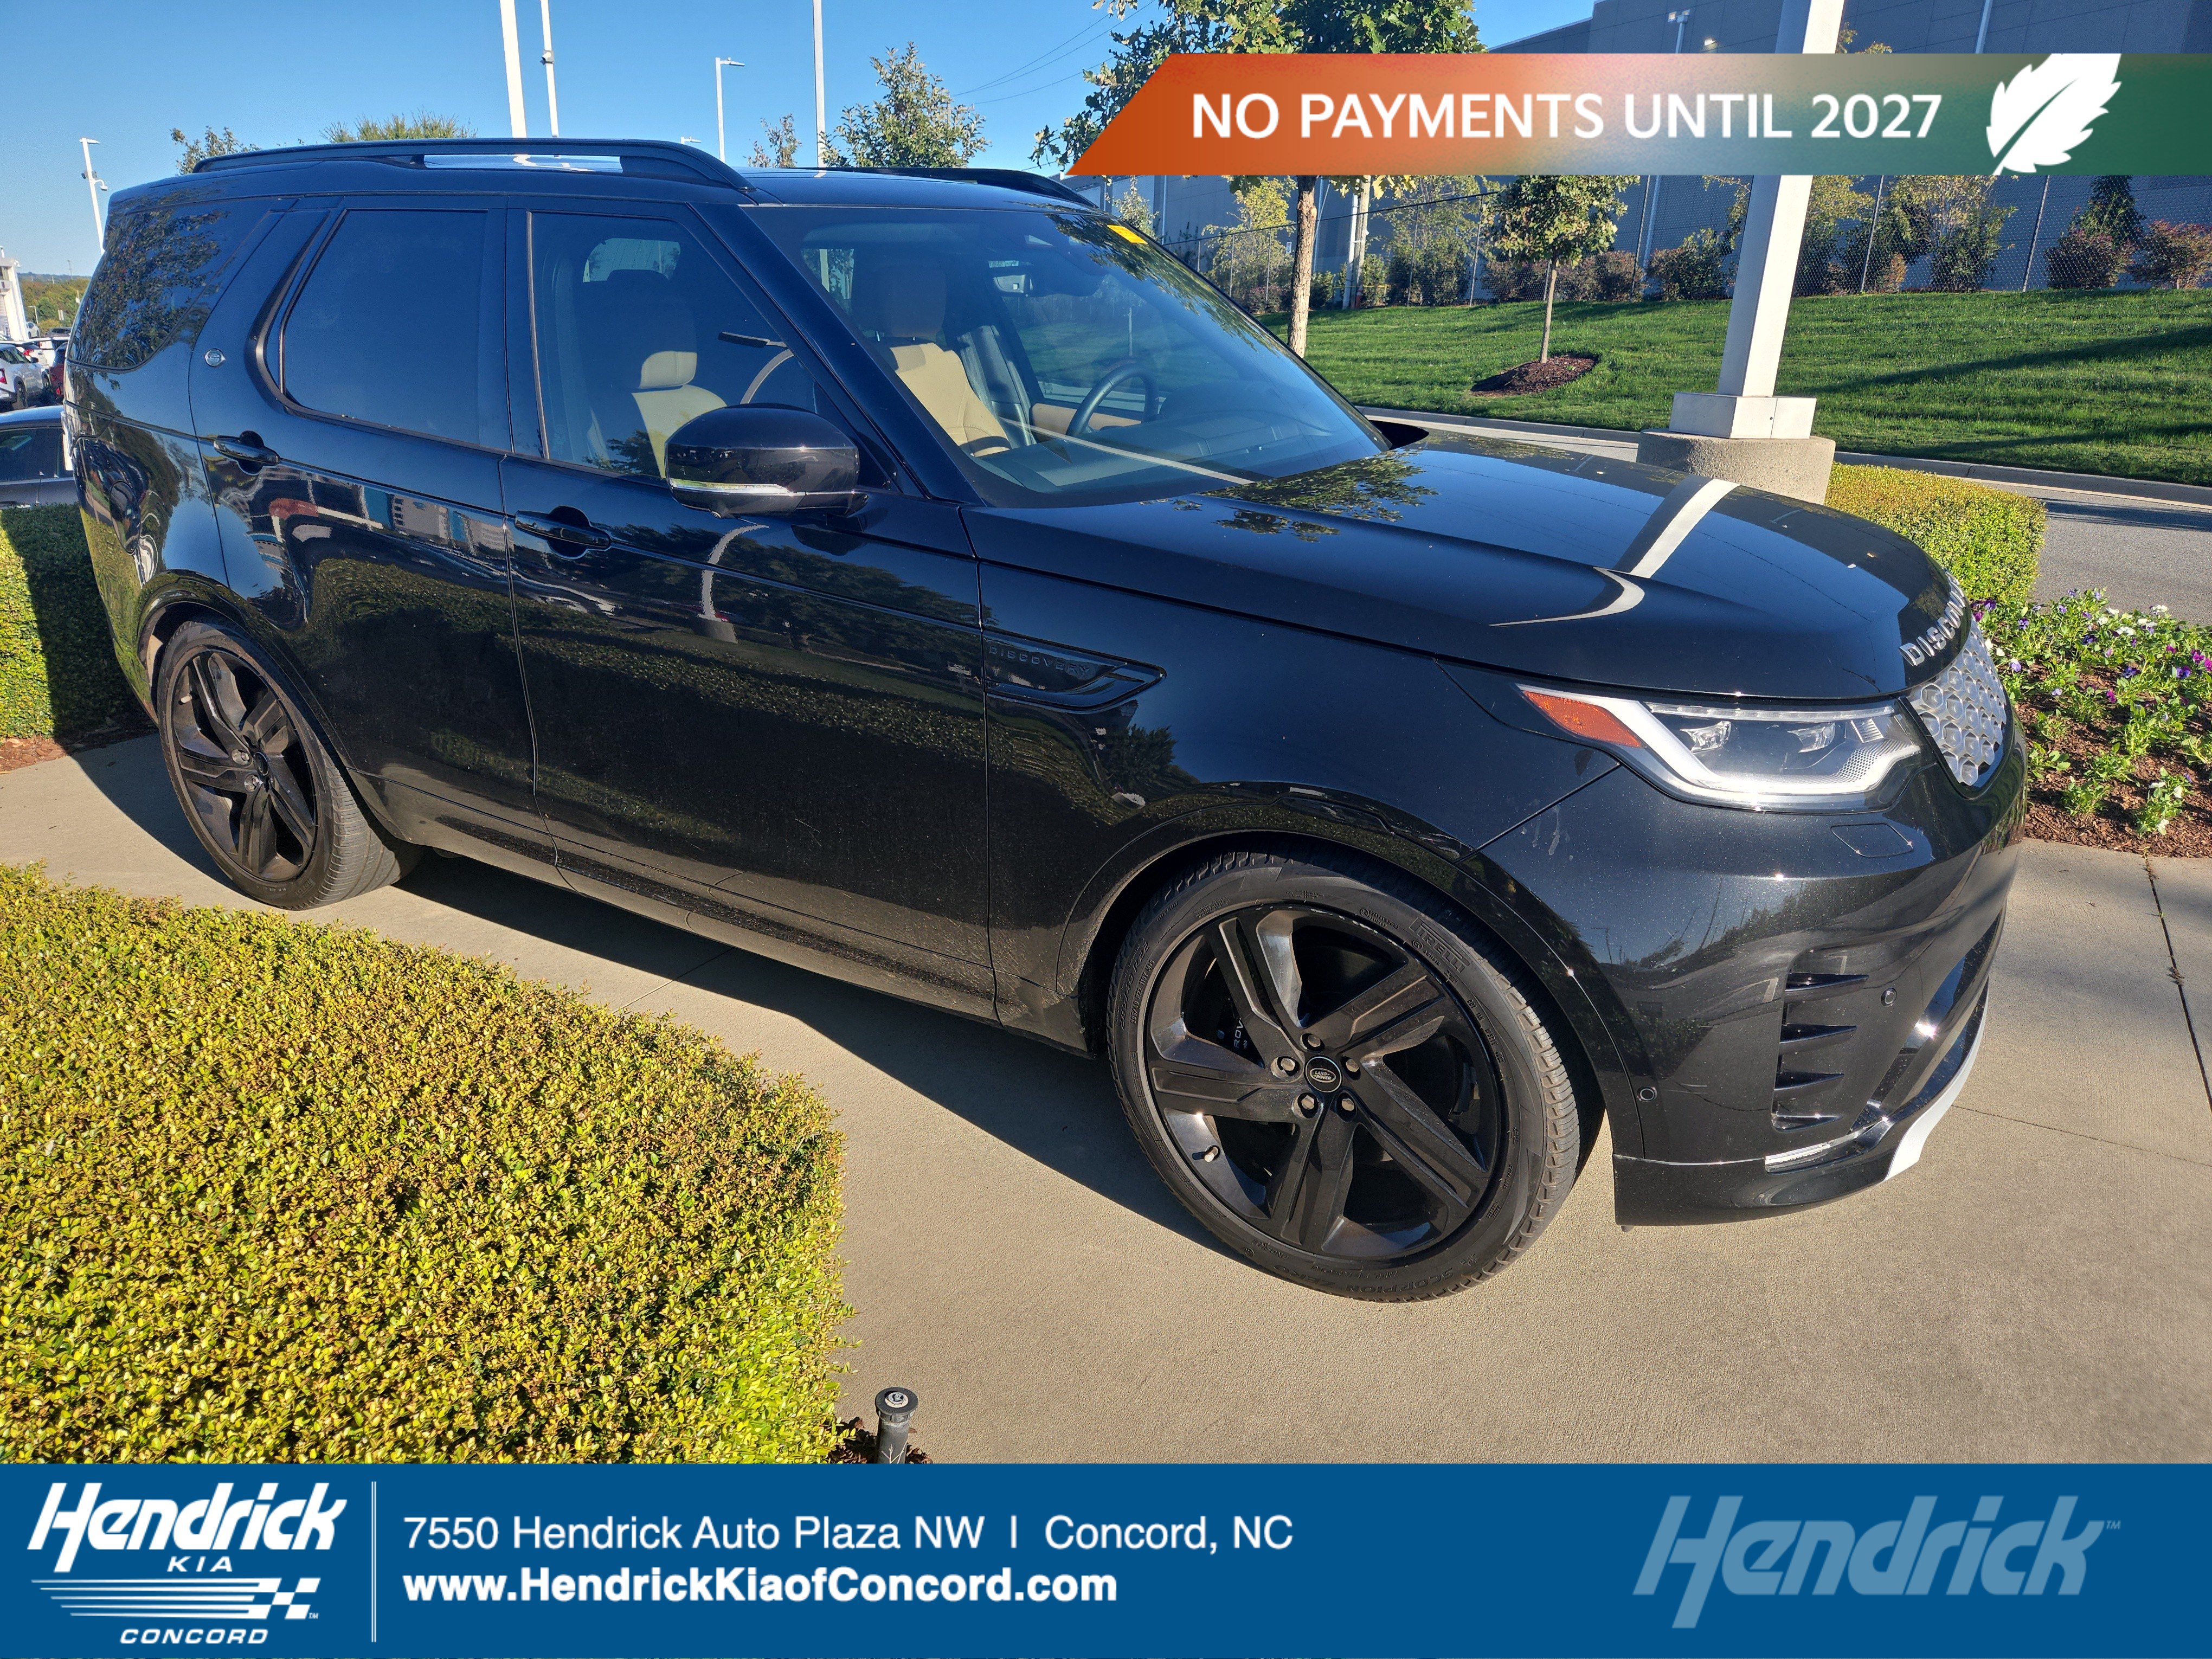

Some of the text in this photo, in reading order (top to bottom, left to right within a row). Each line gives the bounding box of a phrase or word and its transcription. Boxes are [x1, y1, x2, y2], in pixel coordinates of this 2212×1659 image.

[988, 646, 1092, 677] DISCOVERY
[1409, 917, 1471, 974] PIRELLI
[1233, 1018, 1244, 1049] ROV
